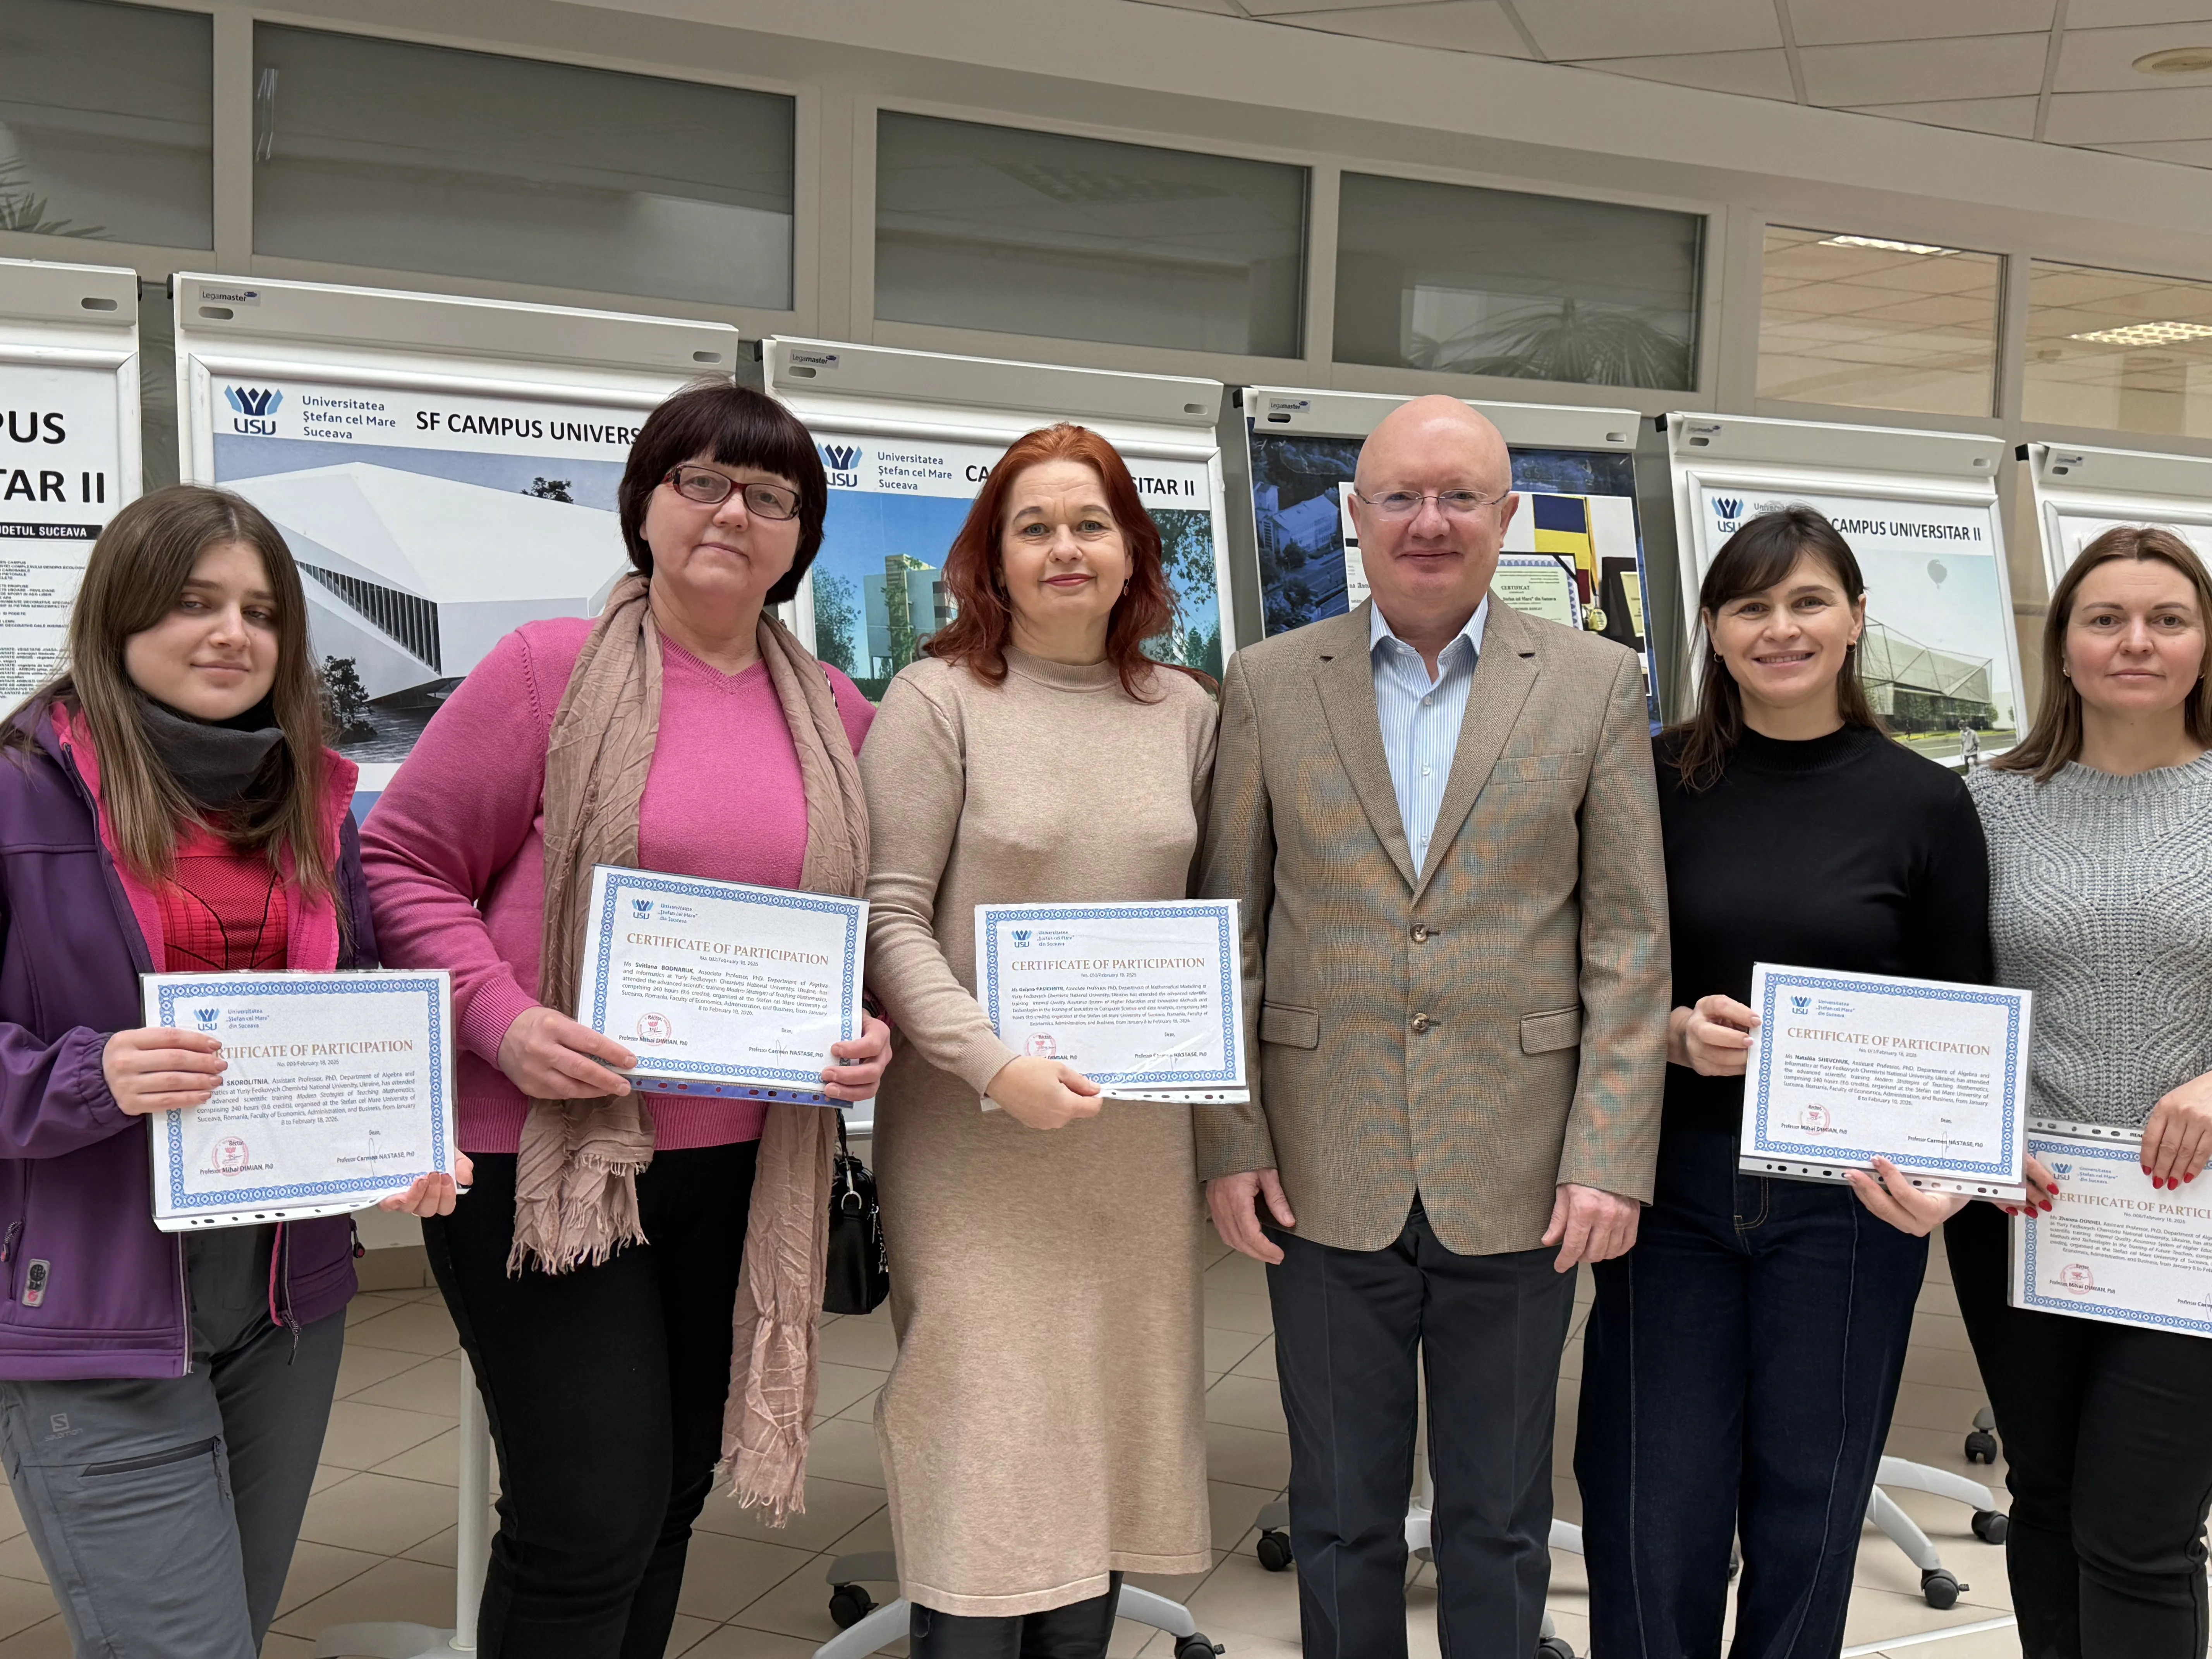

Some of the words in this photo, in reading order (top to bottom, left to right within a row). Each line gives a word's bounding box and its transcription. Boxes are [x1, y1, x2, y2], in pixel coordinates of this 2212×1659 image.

[203, 291, 246, 302] Legamaster
[793, 354, 828, 364] Legamaster
[302, 395, 385, 411] Universitatea
[234, 418, 276, 436] USU
[346, 415, 363, 425] cel
[366, 417, 396, 427] Mare
[416, 411, 440, 430] SF
[448, 414, 543, 438] CAMPUS
[550, 421, 641, 445] UNIVERS
[304, 427, 352, 439] Suceava
[878, 452, 943, 465] Universitatea
[912, 469, 926, 477] cel
[929, 470, 952, 479] Mare
[966, 465, 990, 483] CA
[82, 472, 104, 503] II
[879, 480, 918, 490] Suceava
[1132, 477, 1178, 495] ITAR
[1185, 480, 1194, 496] II
[0, 526, 36, 536] DETUL
[39, 527, 87, 537] SUCEAVA
[1832, 519, 1886, 535] CAMPUS
[1890, 522, 1970, 541] UNIVERSITAR
[1973, 527, 1982, 541] II
[627, 933, 710, 952] CERTIFICATE
[713, 943, 731, 954] OF
[734, 945, 828, 965] PARTICIPATION
[1012, 960, 1090, 971] CERTIFICATE
[1092, 959, 1109, 969] OF
[1113, 958, 1204, 969] PARTICIPATION
[1787, 1027, 1869, 1044] CERTIFICATE
[1872, 1035, 1889, 1046] OF
[1893, 1037, 1990, 1055] PARTICIPATION
[215, 1045, 287, 1060] RTIFICATE
[290, 1044, 308, 1056] OF
[312, 1040, 412, 1055] PARTICIPATION
[2137, 1201, 2155, 1211] OF
